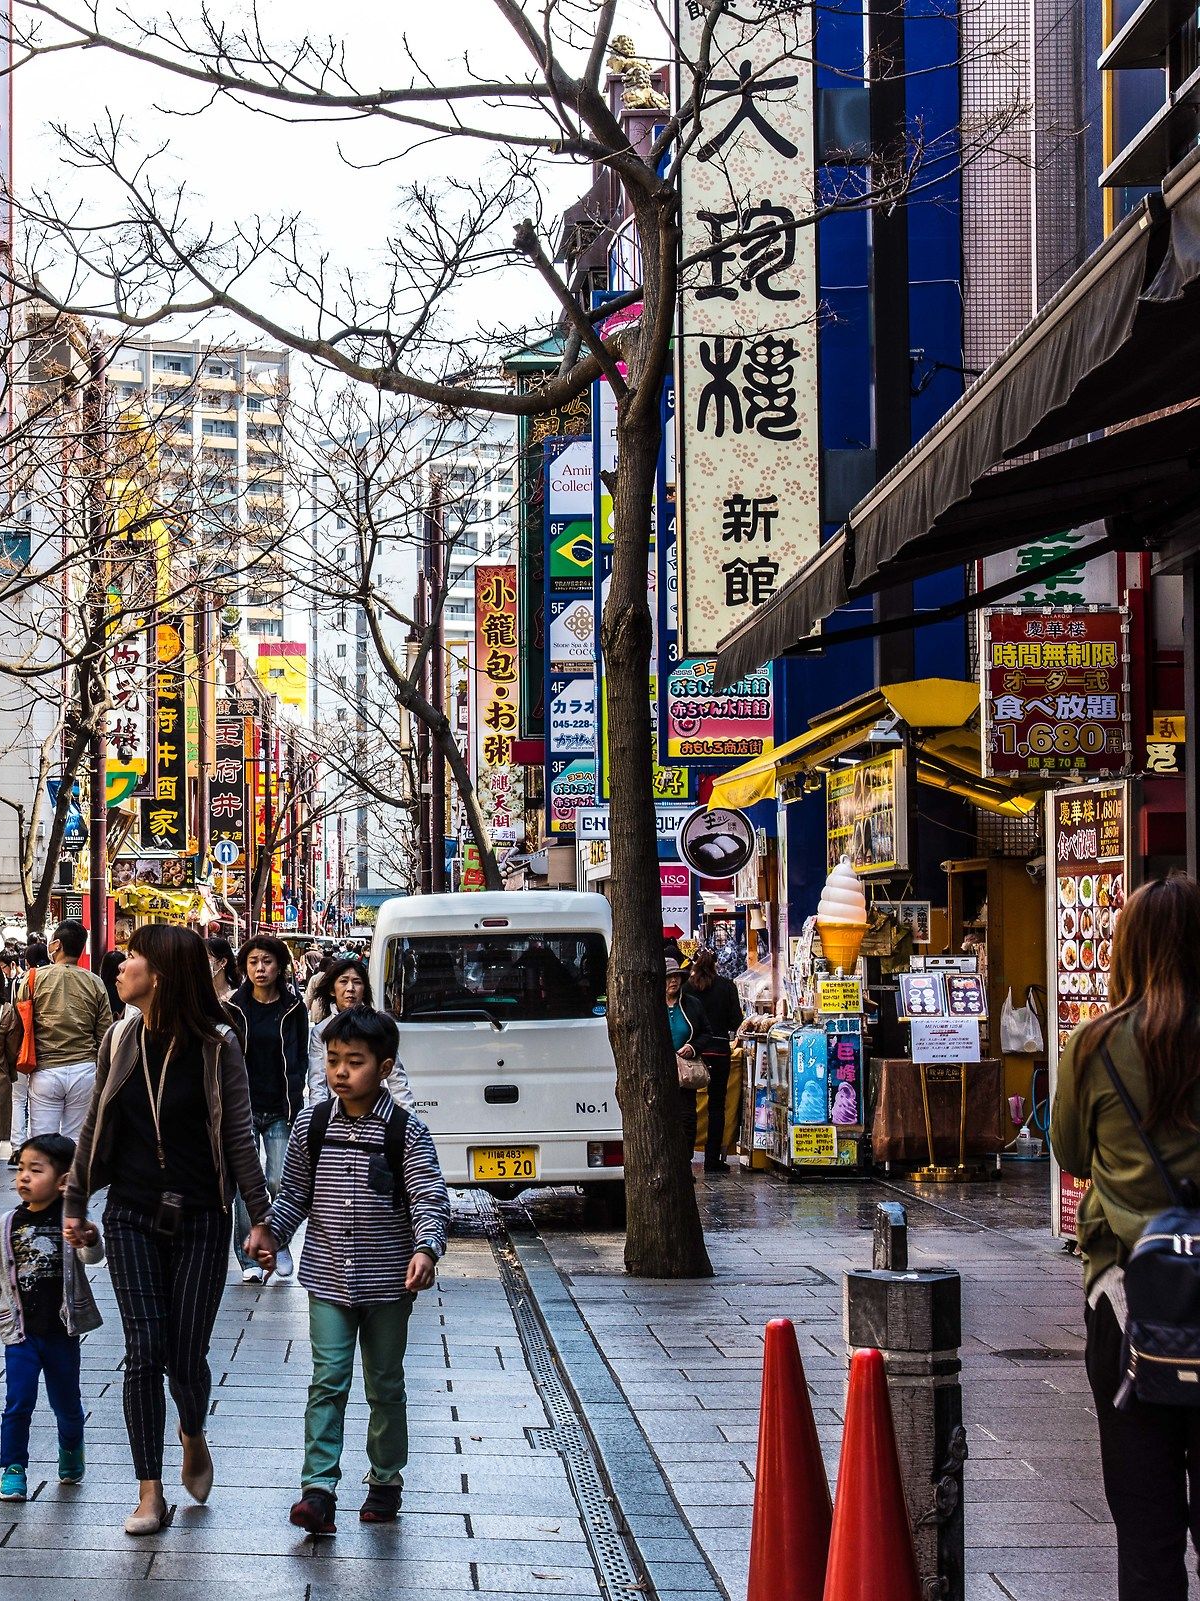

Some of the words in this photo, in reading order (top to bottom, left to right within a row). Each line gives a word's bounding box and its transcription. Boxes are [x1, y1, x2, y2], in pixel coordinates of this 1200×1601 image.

[551, 523, 564, 535] 6F
[721, 493, 779, 607] 新館
[551, 602, 565, 614] 5F
[1025, 621, 1087, 637] 慶華楼
[992, 642, 1118, 669] 時間無制限
[552, 681, 564, 693] 4F
[1004, 669, 1110, 692] オーダー式
[670, 700, 771, 720] 赤ちゃん水族館
[992, 694, 1119, 722] 食べ放題
[680, 739, 763, 755] おもしろ商店街
[999, 723, 1123, 758] 1,680円
[211, 723, 243, 818] 王府井
[552, 762, 565, 773] 3F
[1028, 757, 1087, 768] 限定70品
[1059, 799, 1095, 826] 慶華楼
[462, 828, 498, 839] 花字
[806, 1038, 817, 1068] ソーダ
[576, 1102, 608, 1113] No.1
[506, 1151, 521, 1159] 483
